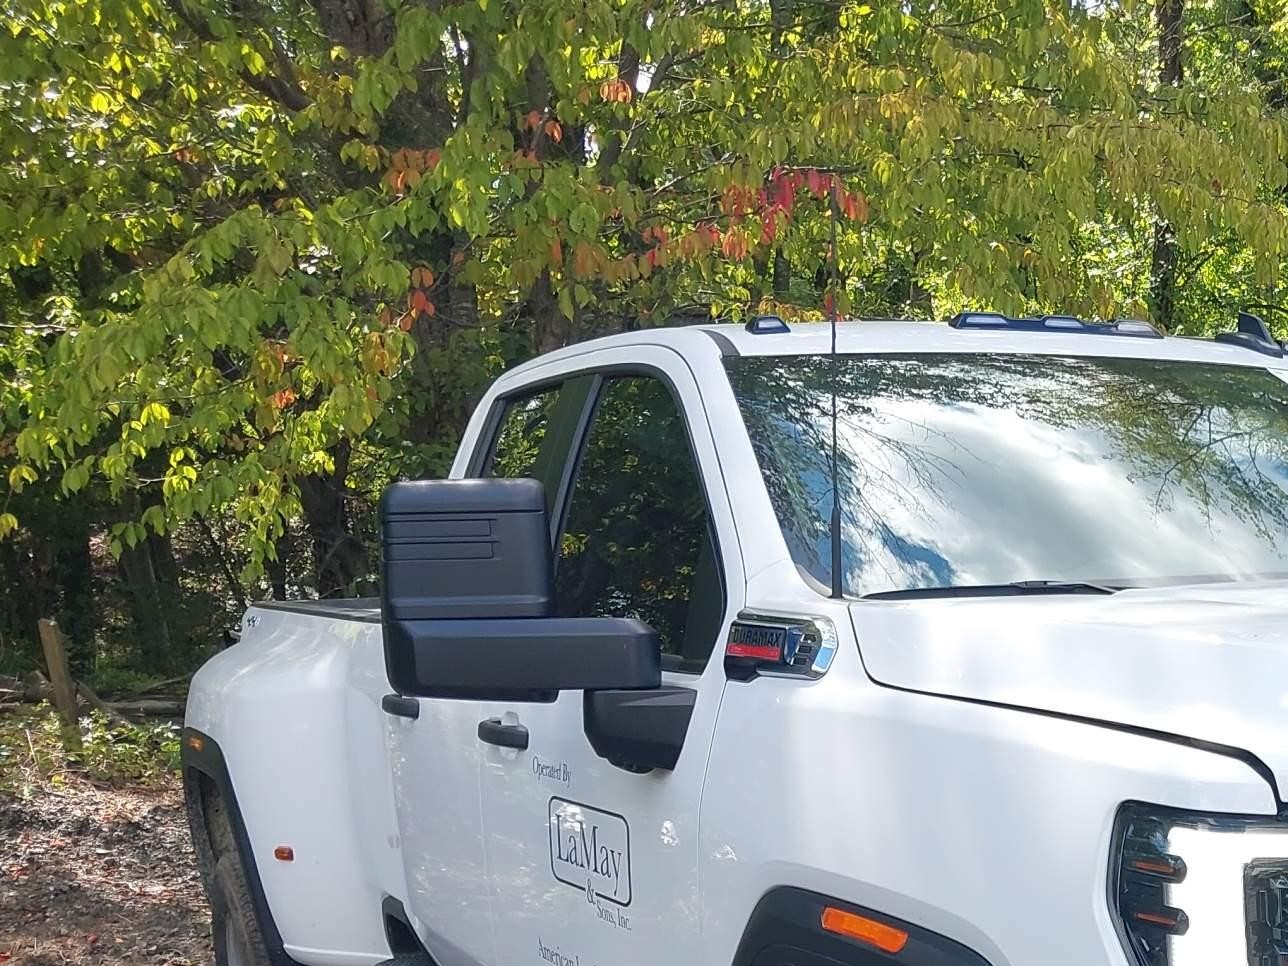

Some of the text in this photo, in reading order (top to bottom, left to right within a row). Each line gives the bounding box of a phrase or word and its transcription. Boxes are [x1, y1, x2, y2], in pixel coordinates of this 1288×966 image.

[733, 628, 782, 649] DURAMAX
[532, 756, 572, 787] Operated By
[555, 814, 622, 897] LaMay
[586, 878, 596, 904] &
[596, 901, 632, 931] Sons, Inc.
